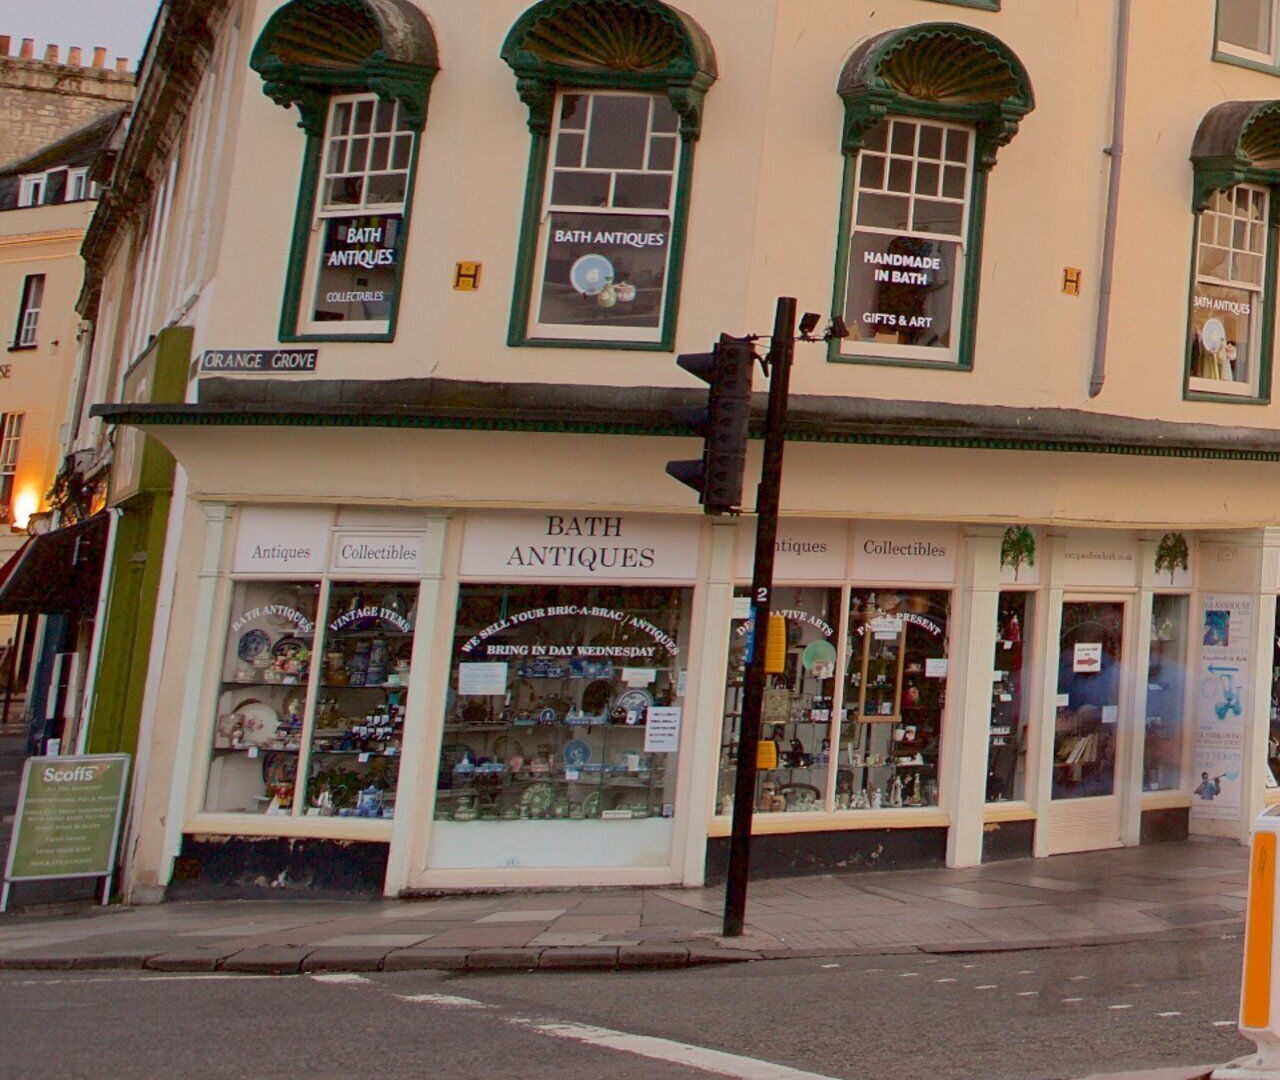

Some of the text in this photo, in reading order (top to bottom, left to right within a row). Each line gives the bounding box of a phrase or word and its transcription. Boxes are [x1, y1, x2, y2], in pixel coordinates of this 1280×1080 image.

[347, 227, 382, 243] BATH
[554, 230, 664, 248] BATH ANTIQUES
[328, 249, 394, 269] ANTIQUES
[863, 251, 940, 269] HANDMADE
[874, 269, 927, 285] IN BATH
[1213, 299, 1250, 315] ANTIQUES
[862, 312, 933, 328] GIFTS & ART
[204, 353, 315, 368] ORANGE GROVE
[544, 516, 622, 537] BATH
[252, 544, 311, 561] Antiques
[341, 544, 417, 561] Collectibles
[863, 540, 946, 557] Collectibles
[506, 546, 655, 571] ANTIQUES
[757, 587, 768, 602] 2
[232, 605, 314, 633] BATH ANTIQUES
[330, 606, 411, 633] VINTAGE ITEMS
[808, 616, 834, 637] ARTS
[896, 612, 942, 636] PRESENT
[461, 636, 479, 654] WE
[479, 619, 511, 640] SELL
[510, 607, 546, 625] YOUR
[547, 605, 624, 621] BRIC-A-BRAC
[629, 617, 681, 656] ANTIQUES
[486, 645, 656, 658] BRING IN DAY WEDNESDAY
[44, 765, 94, 782] Scoffs
